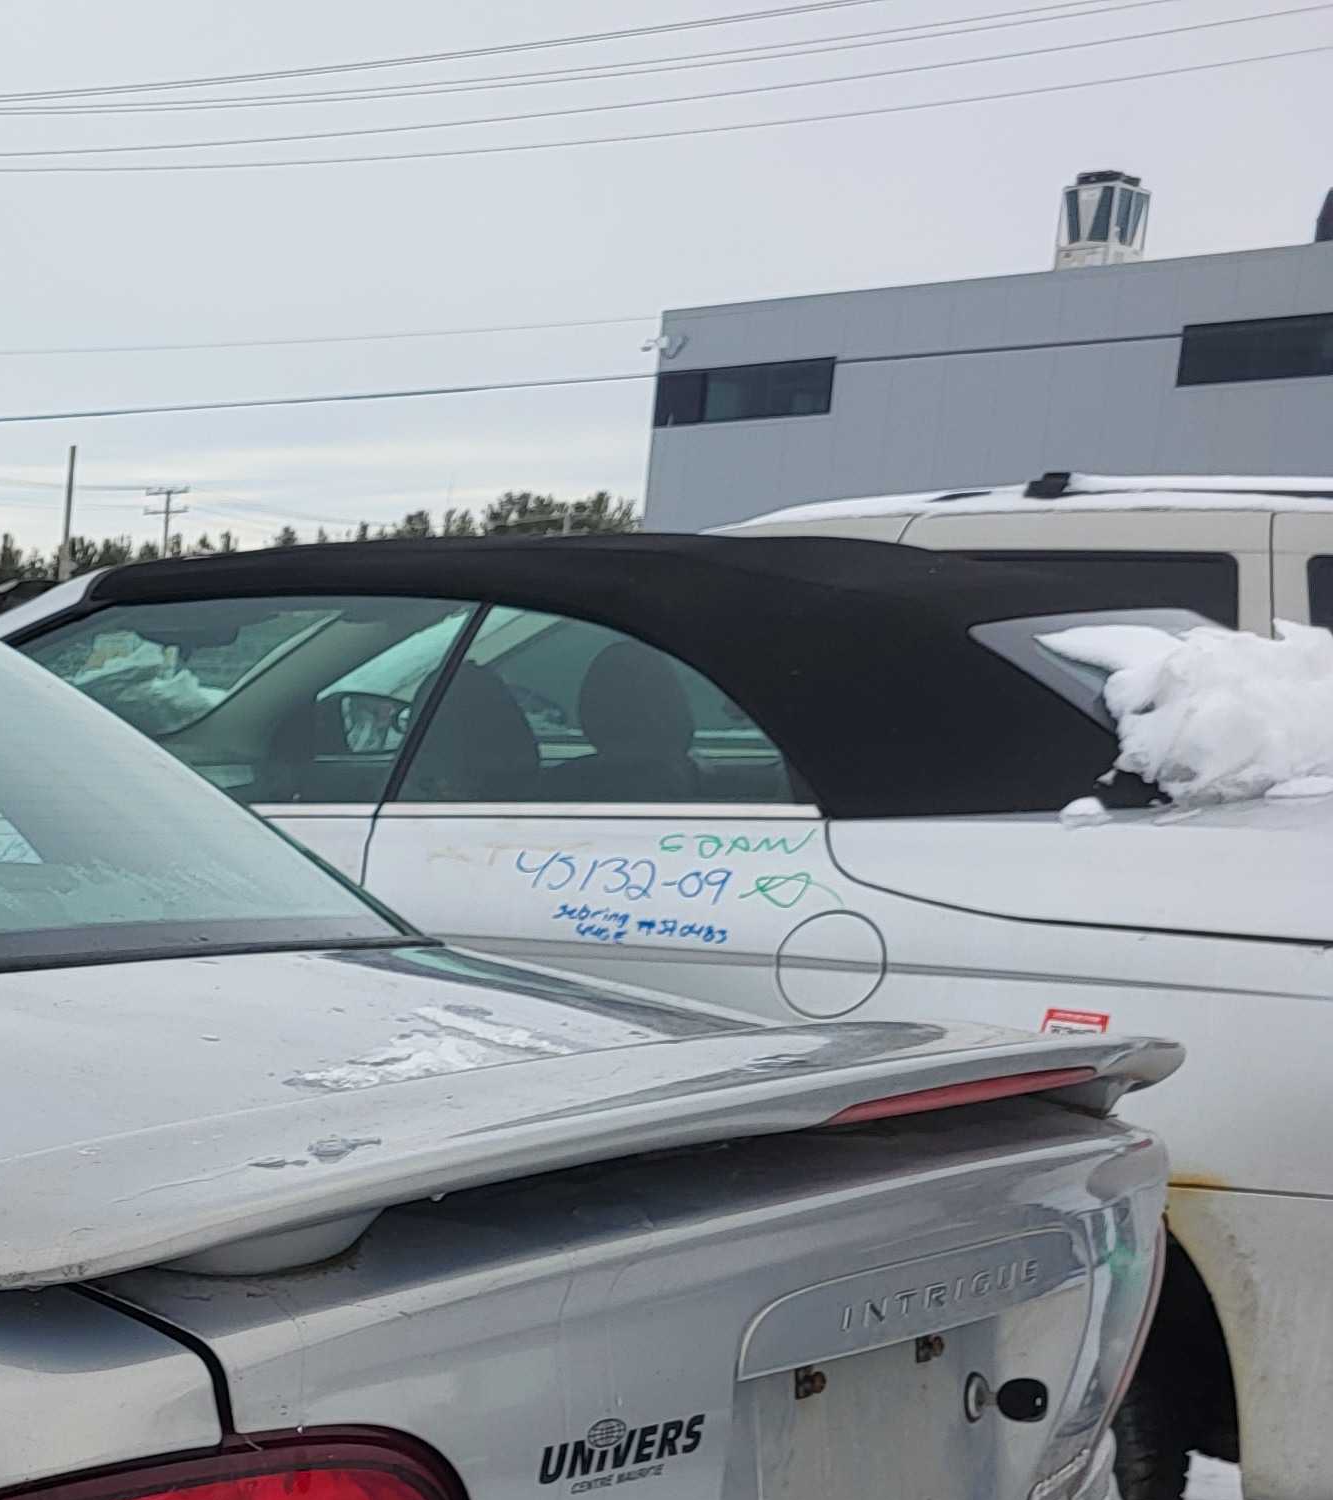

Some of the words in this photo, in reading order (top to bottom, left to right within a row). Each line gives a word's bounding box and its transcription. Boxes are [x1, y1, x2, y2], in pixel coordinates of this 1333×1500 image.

[516, 850, 733, 904] 45132-09
[839, 1256, 1039, 1333] INTRIGUE
[539, 1413, 707, 1486] UNIVERS
